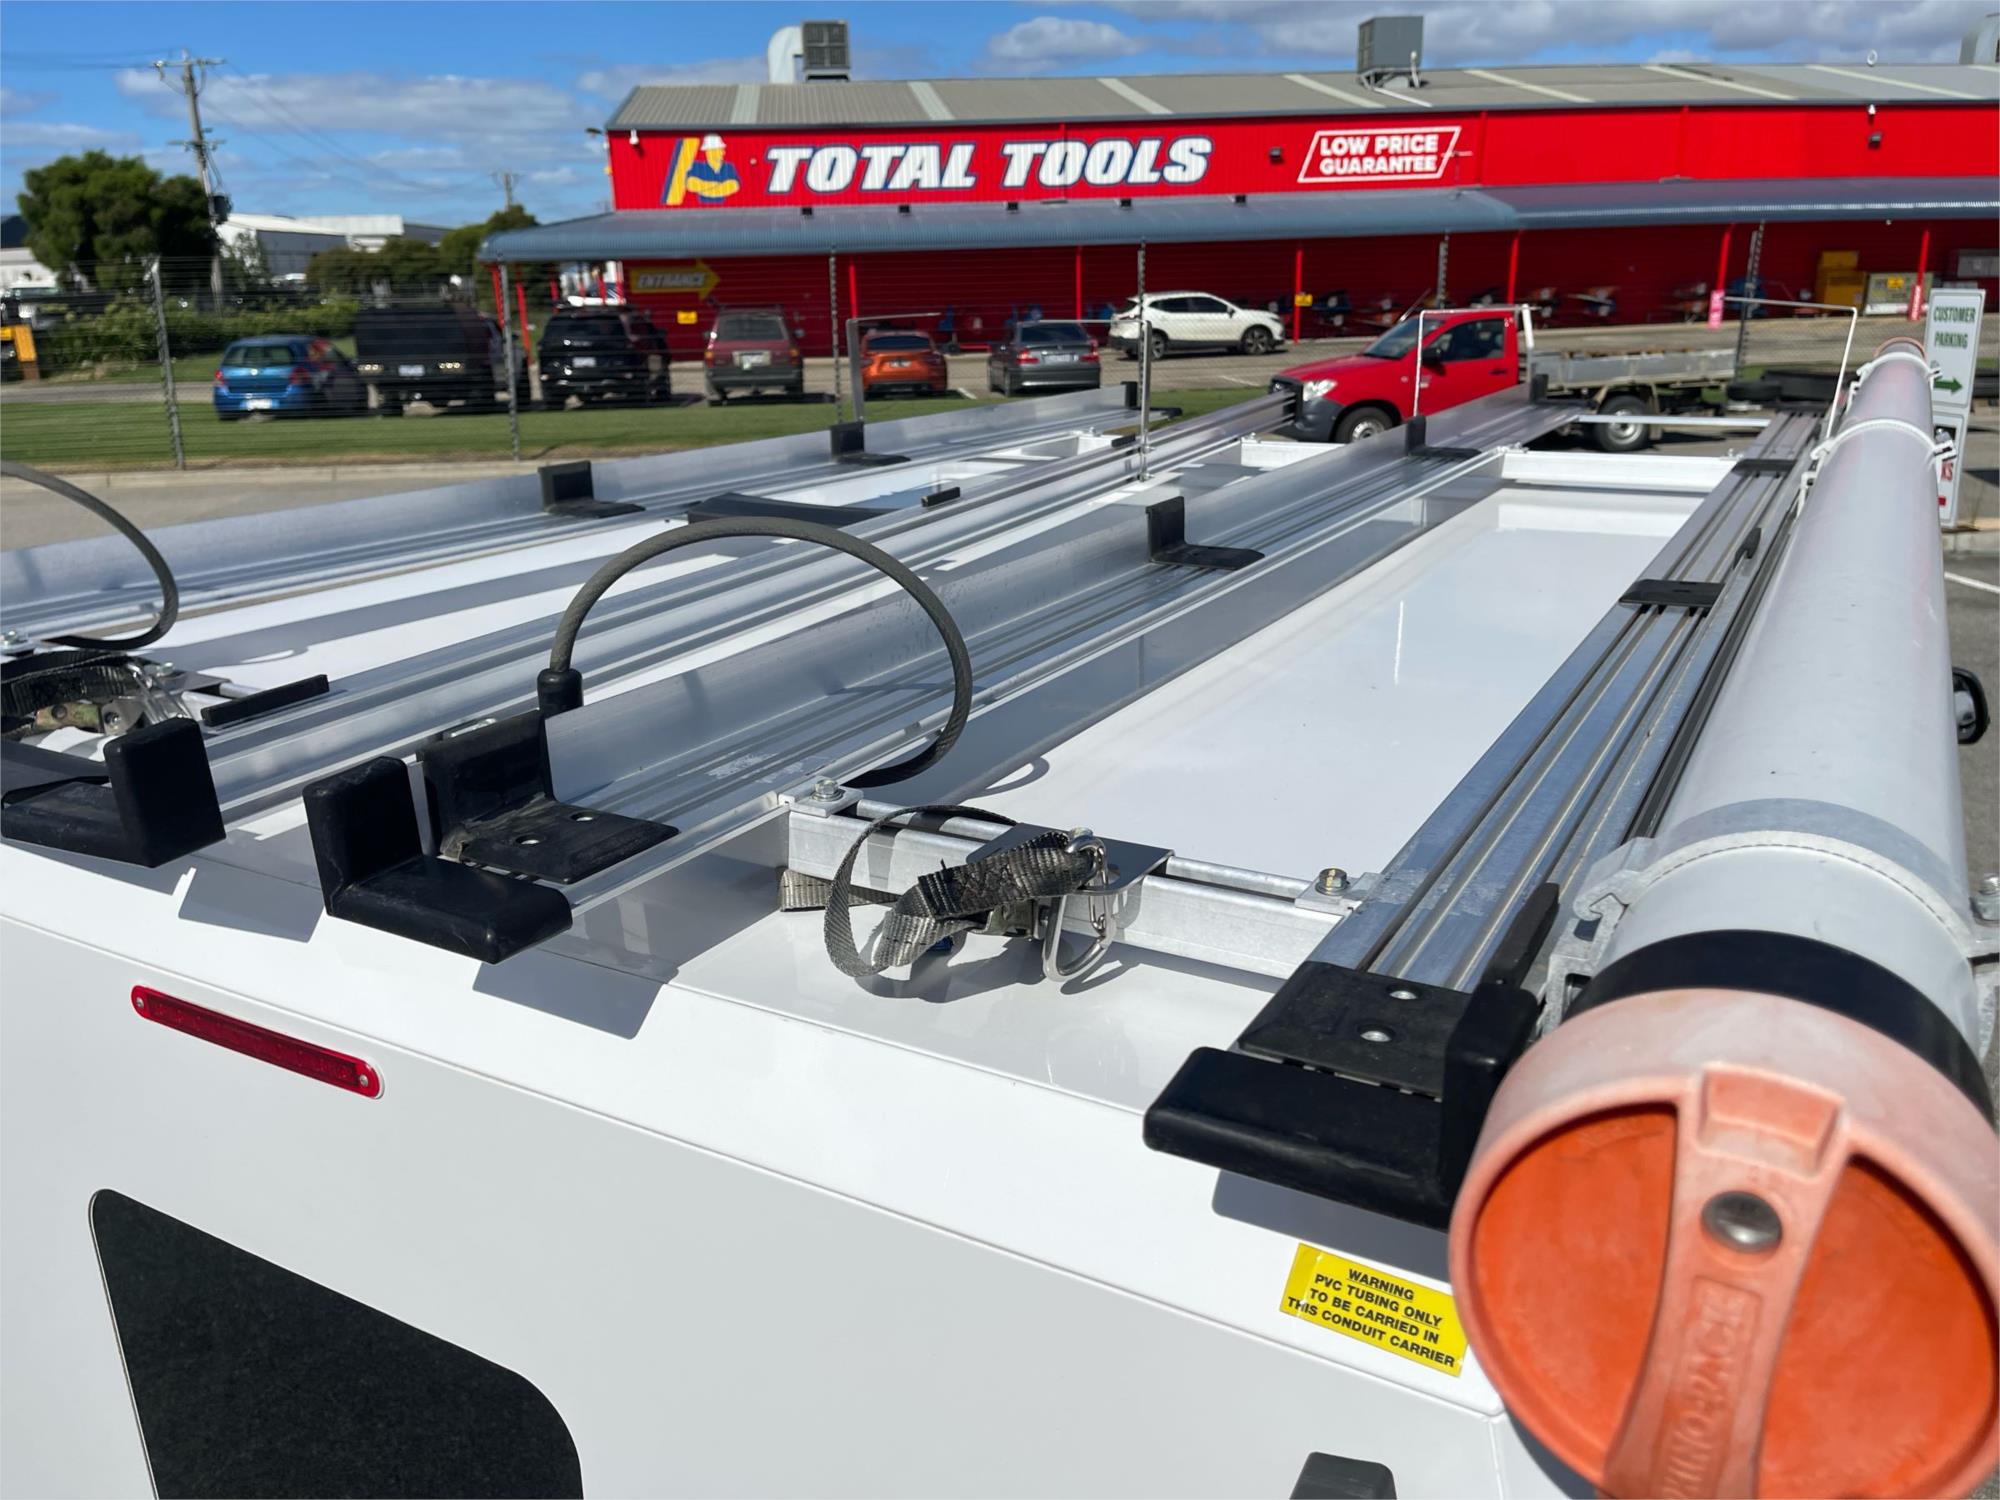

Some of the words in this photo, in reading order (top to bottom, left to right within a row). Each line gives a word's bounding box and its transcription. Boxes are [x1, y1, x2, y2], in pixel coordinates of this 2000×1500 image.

[1319, 136, 1370, 156] LOW
[1374, 133, 1439, 155] PRICE
[766, 143, 978, 193] TOTAL
[1001, 137, 1213, 188] TOOLS
[1319, 154, 1438, 176] GUARANTEE
[1933, 306, 1976, 323] CUSTOMER
[1934, 331, 1969, 349] PARKING
[1314, 1273, 1343, 1291] PVC
[1347, 1284, 1400, 1312] TUBING
[1403, 1305, 1443, 1327] ONLY
[1348, 1268, 1415, 1300] WARNING
[1288, 1296, 1318, 1316] THIS
[1321, 1310, 1386, 1341] CONDUIT
[1389, 1335, 1455, 1367] CARRIER
[1310, 1288, 1328, 1303] TO
[1332, 1296, 1351, 1311] BE
[1355, 1305, 1420, 1336] CARRIED
[1424, 1329, 1440, 1344] IN
